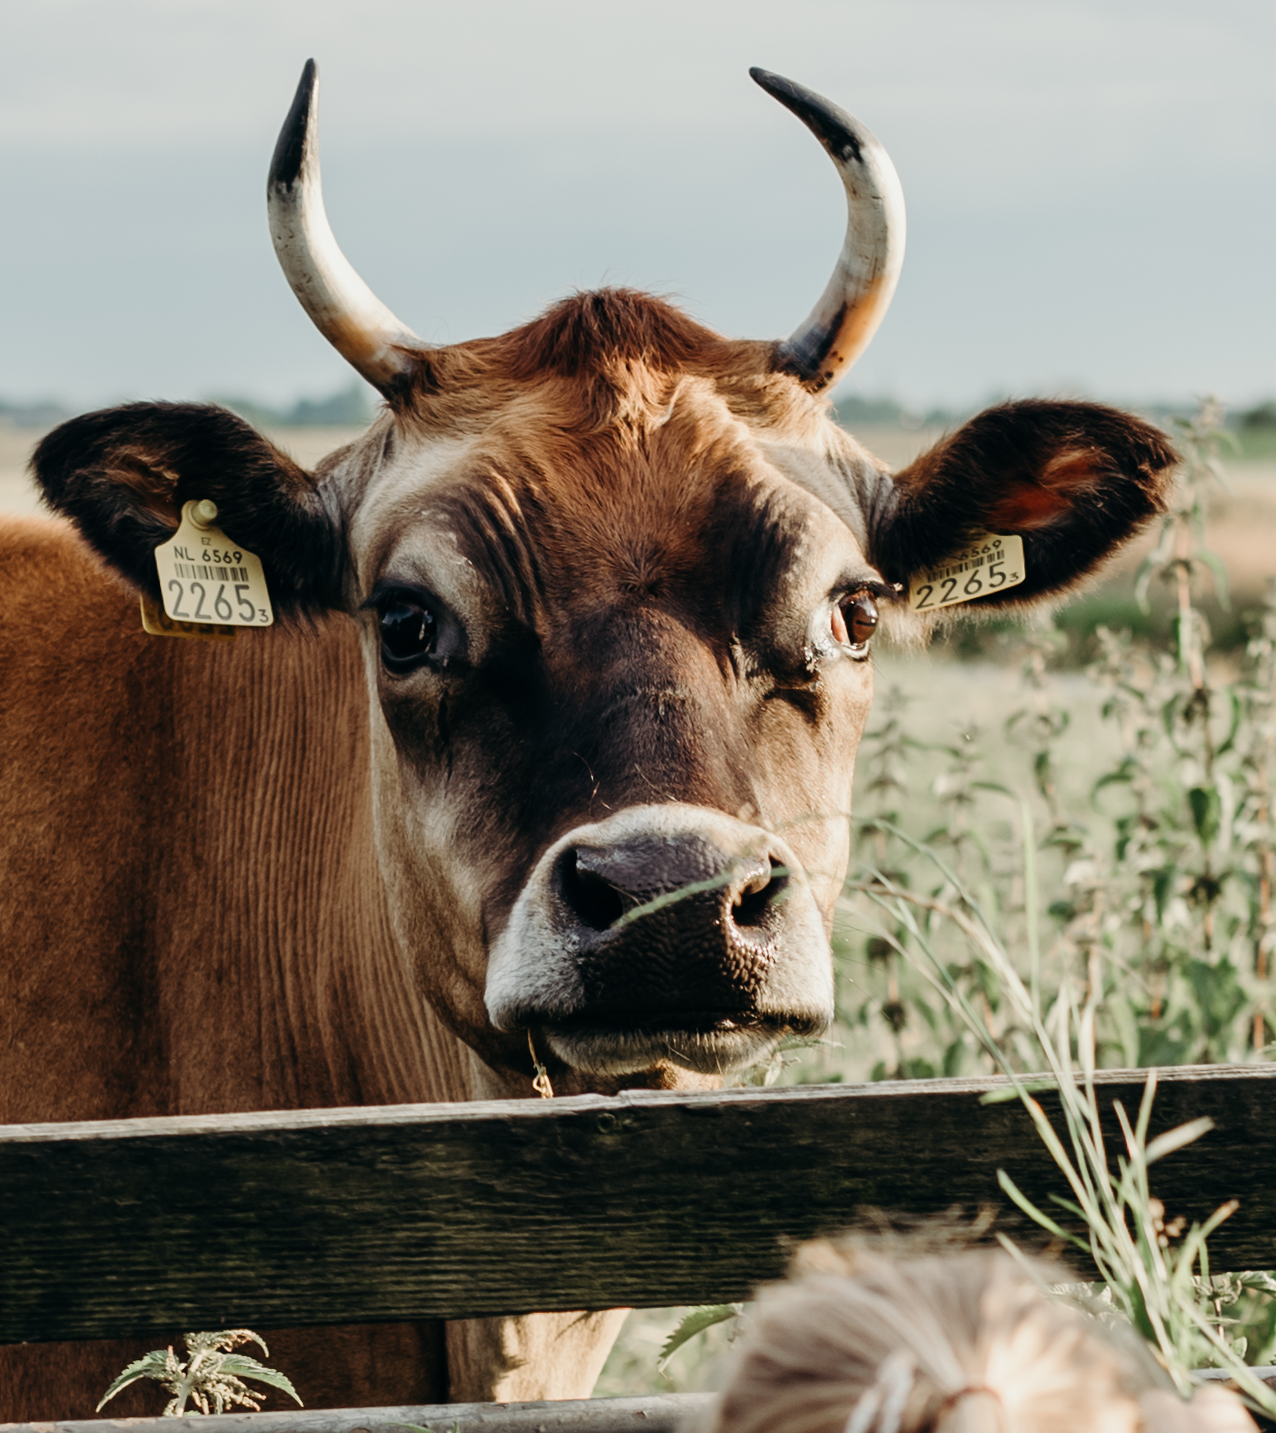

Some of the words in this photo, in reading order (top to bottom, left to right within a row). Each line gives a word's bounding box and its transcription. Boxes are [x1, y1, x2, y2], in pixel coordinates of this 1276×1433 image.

[173, 546, 195, 561] NL
[202, 549, 242, 564] 6569
[168, 579, 255, 622] 2265
[258, 609, 268, 622] 3
[916, 562, 1006, 609] 2265
